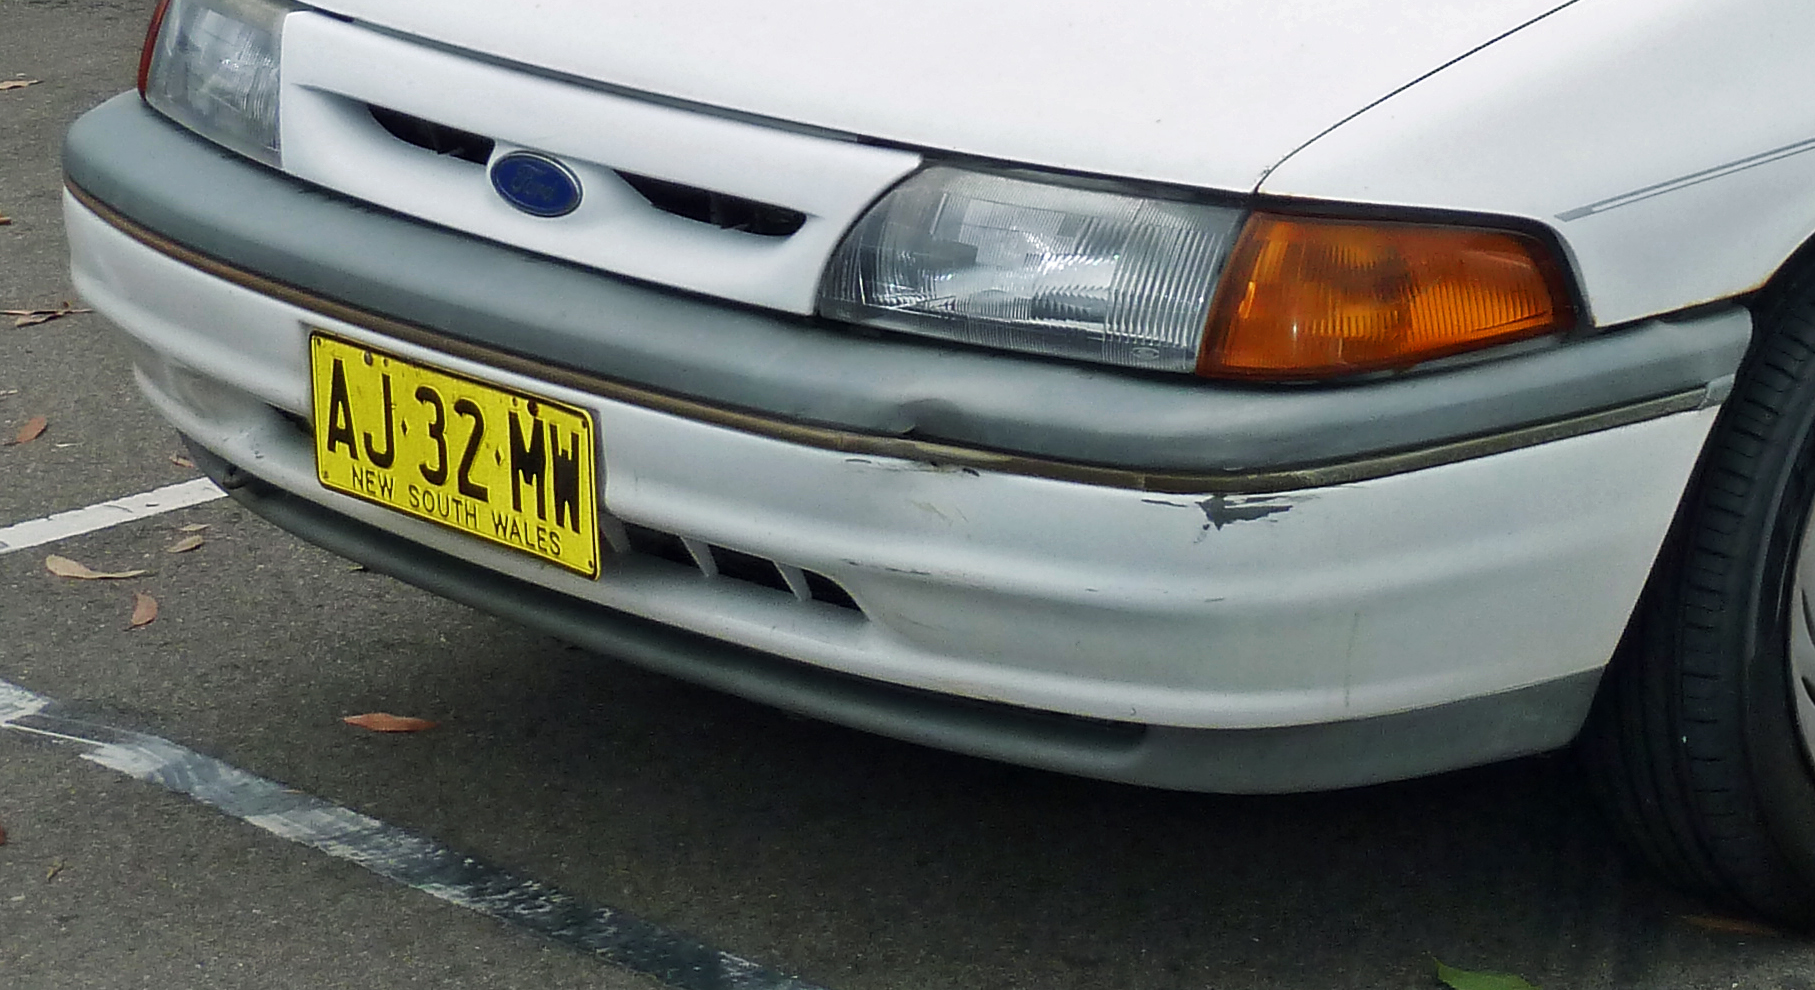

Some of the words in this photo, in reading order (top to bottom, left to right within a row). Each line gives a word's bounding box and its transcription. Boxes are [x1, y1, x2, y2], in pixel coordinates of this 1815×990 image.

[352, 464, 396, 501] NEW
[408, 484, 479, 529] SOUTH
[492, 511, 562, 557] WALES
